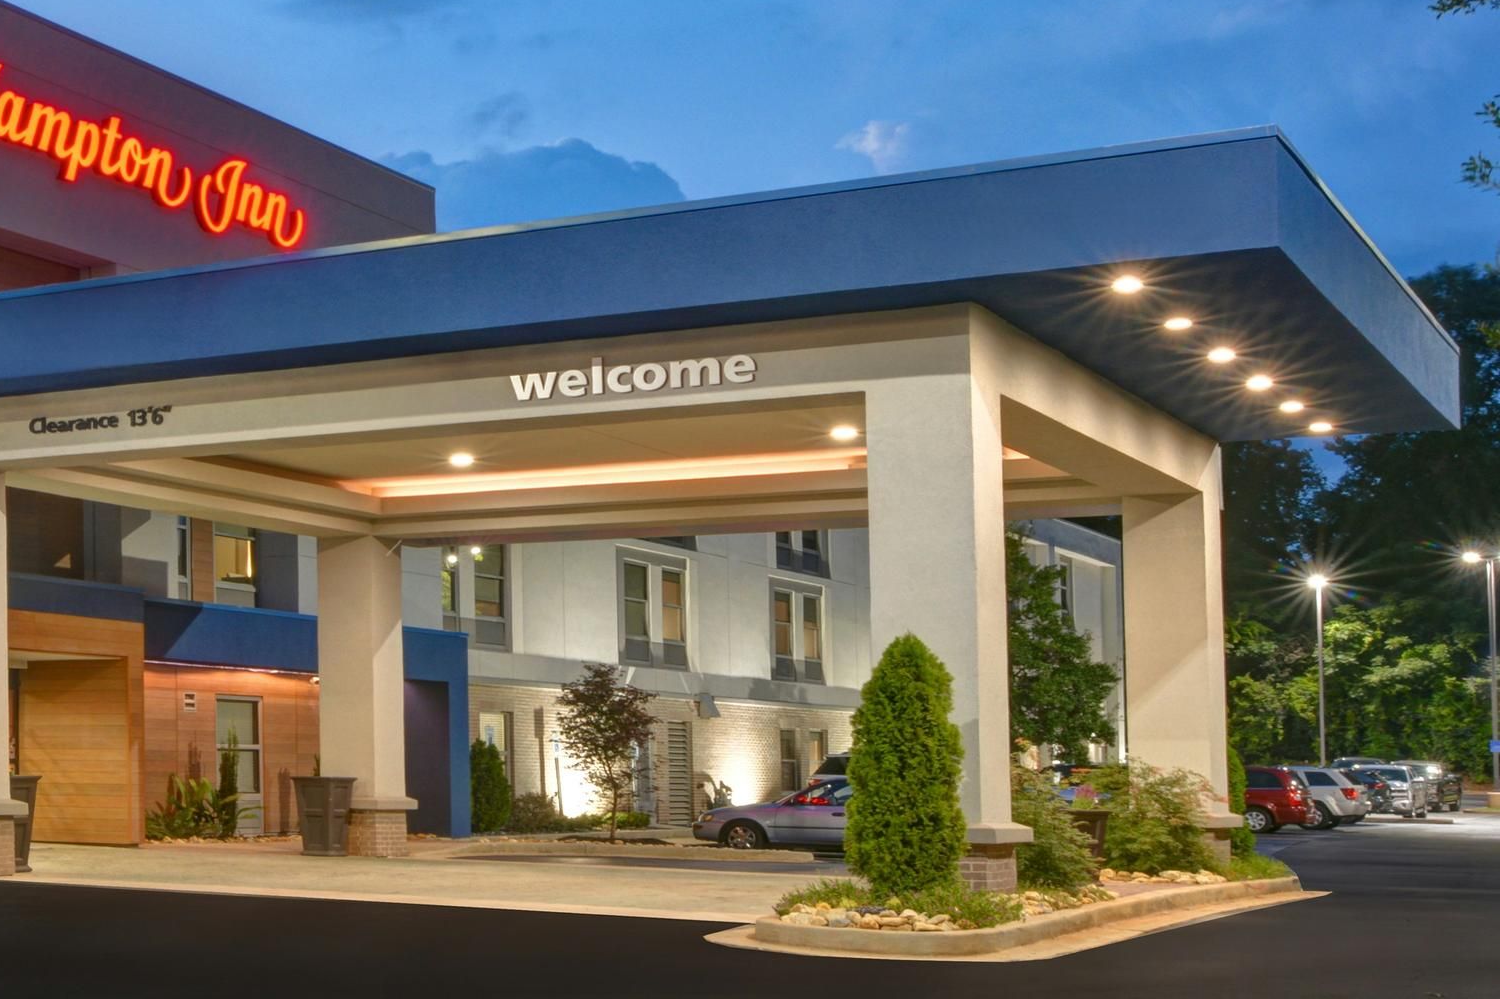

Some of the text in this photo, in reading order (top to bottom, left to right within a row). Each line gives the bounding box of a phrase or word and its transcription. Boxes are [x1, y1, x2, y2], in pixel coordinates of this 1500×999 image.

[194, 159, 304, 249] Inn
[509, 354, 758, 401] welcome
[29, 416, 119, 434] Clearance
